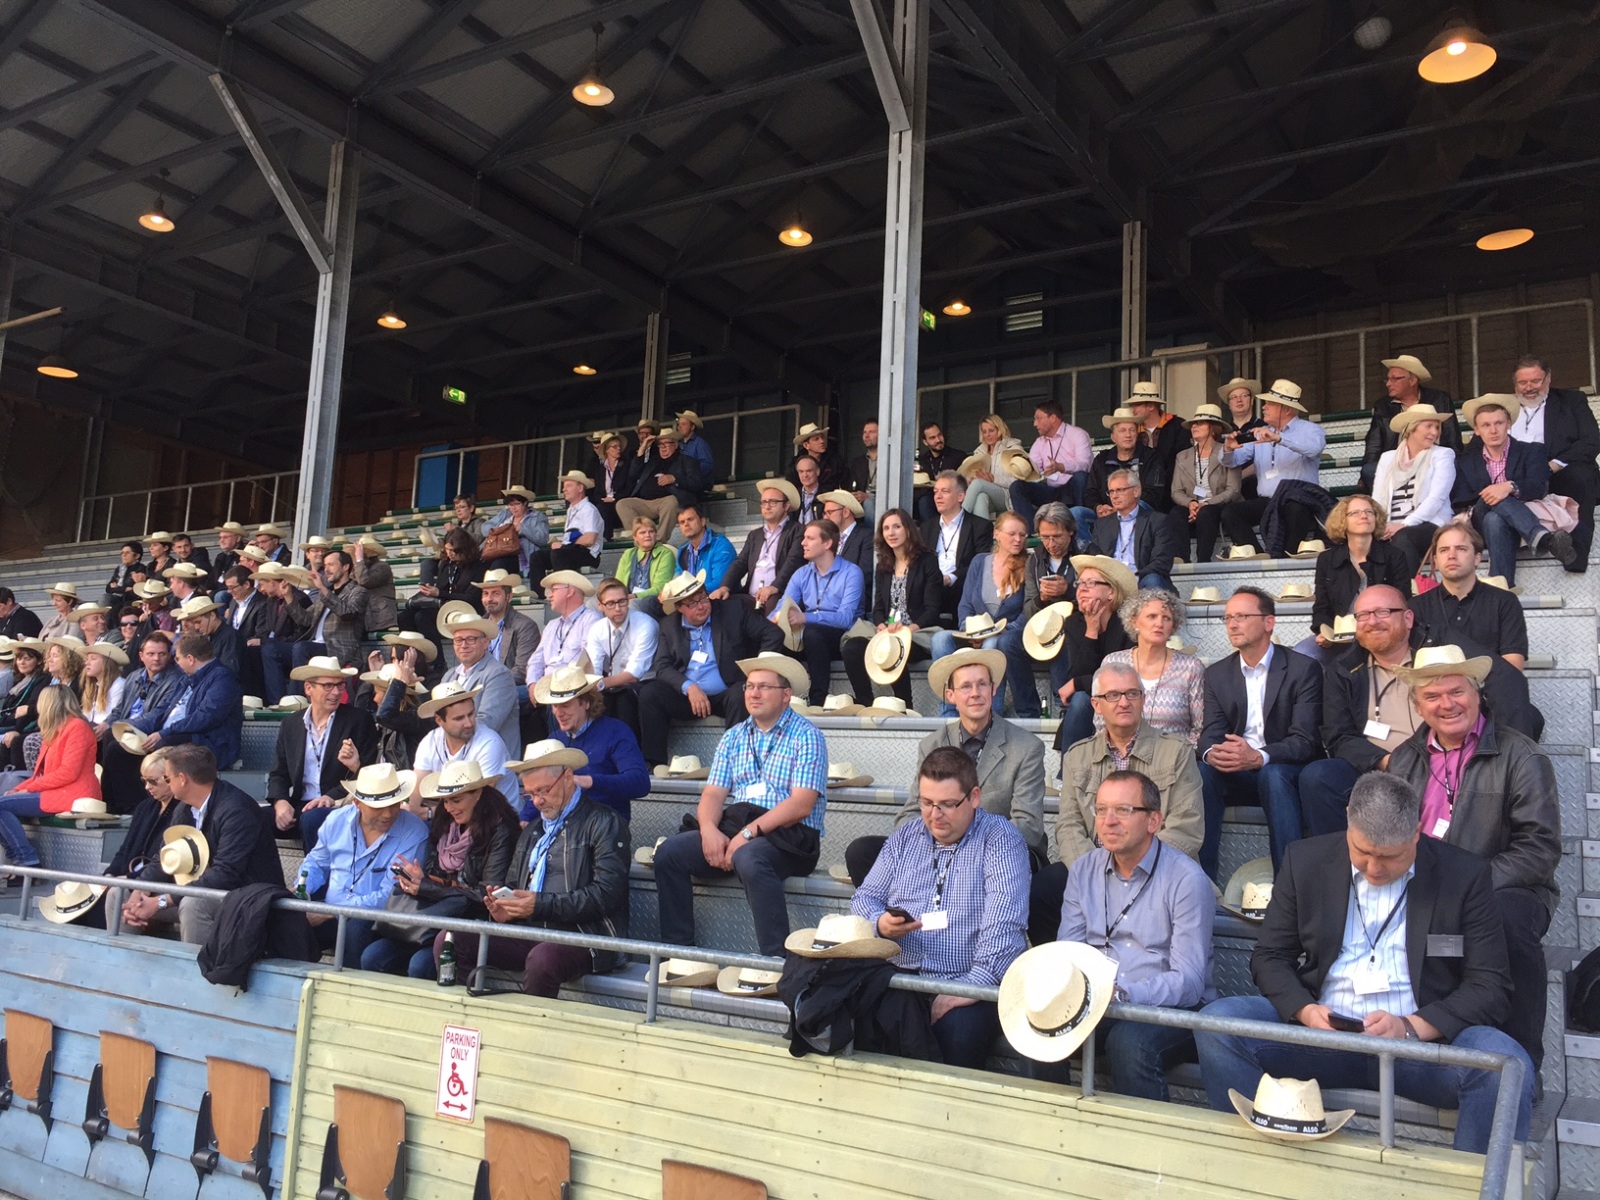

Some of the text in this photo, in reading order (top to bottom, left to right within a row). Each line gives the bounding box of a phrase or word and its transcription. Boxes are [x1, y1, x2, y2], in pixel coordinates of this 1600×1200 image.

[1055, 1025, 1072, 1037] ALSO
[445, 1031, 476, 1048] PARKING
[450, 1047, 469, 1061] ONLY
[1255, 1116, 1268, 1126] ALSO
[1302, 1125, 1319, 1133] ALSO
